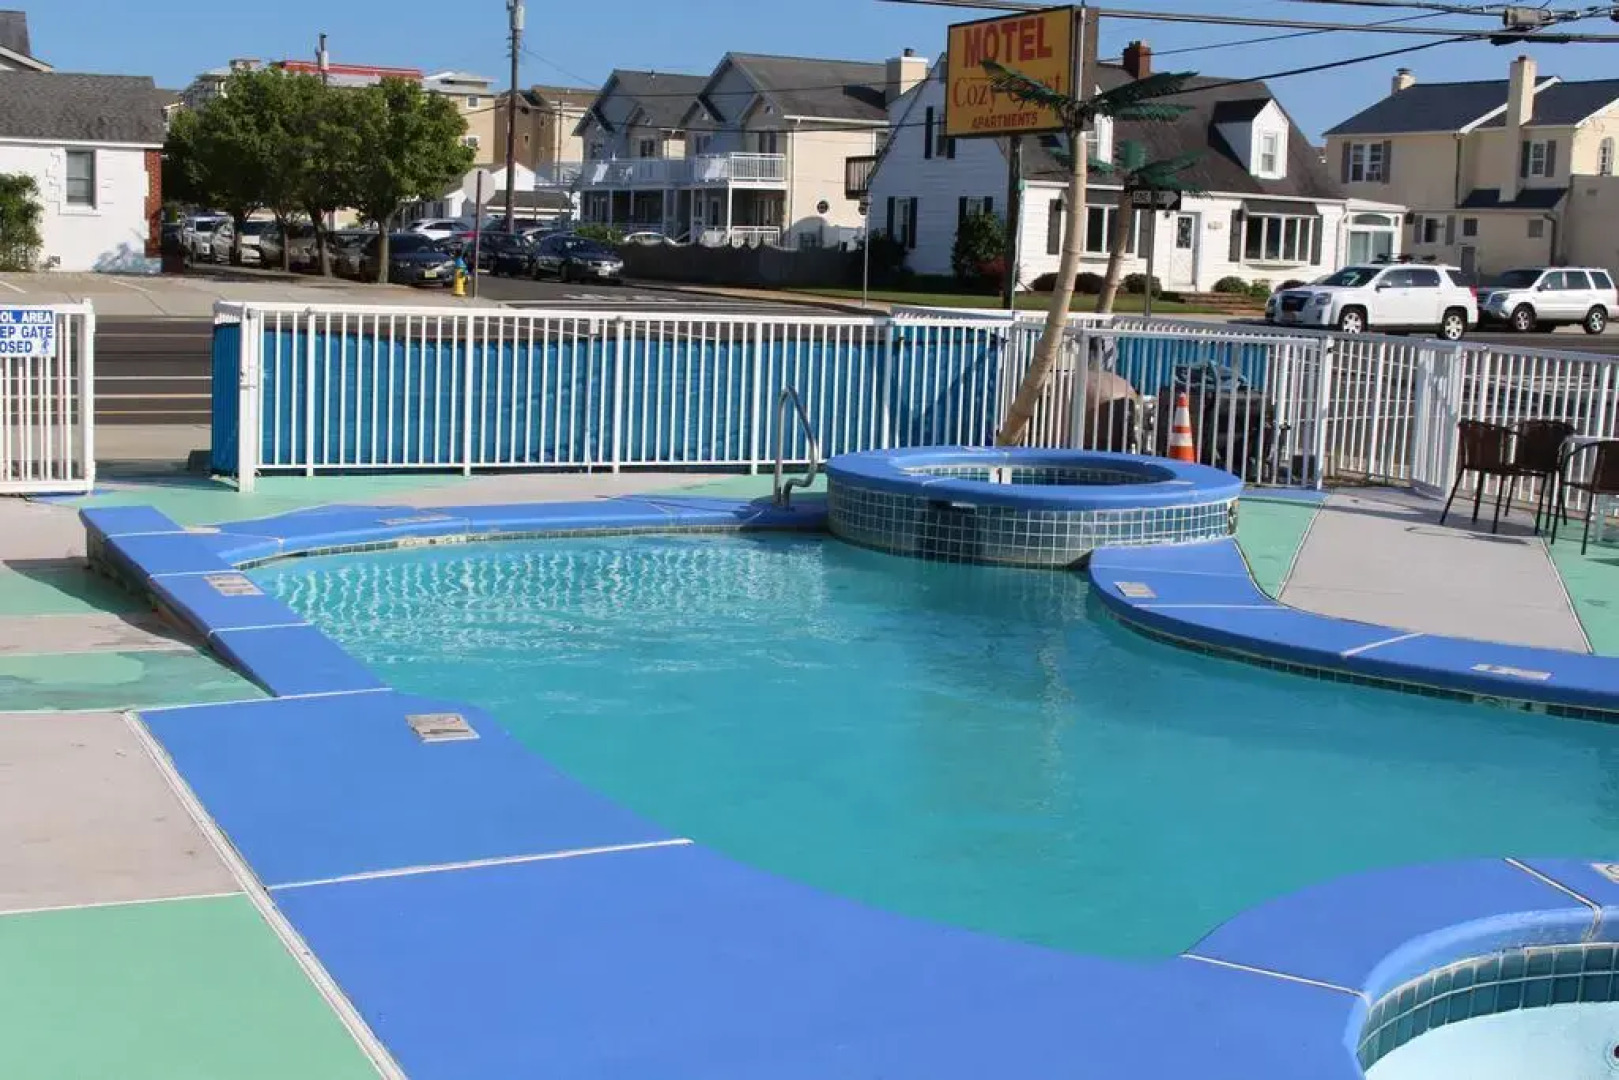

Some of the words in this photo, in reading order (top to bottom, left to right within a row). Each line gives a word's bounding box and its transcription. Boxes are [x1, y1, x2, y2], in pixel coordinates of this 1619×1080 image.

[964, 17, 1052, 68] MOTEL
[972, 111, 1038, 128] APARTMENTS
[22, 311, 52, 323] AREA
[22, 326, 52, 338] GATE
